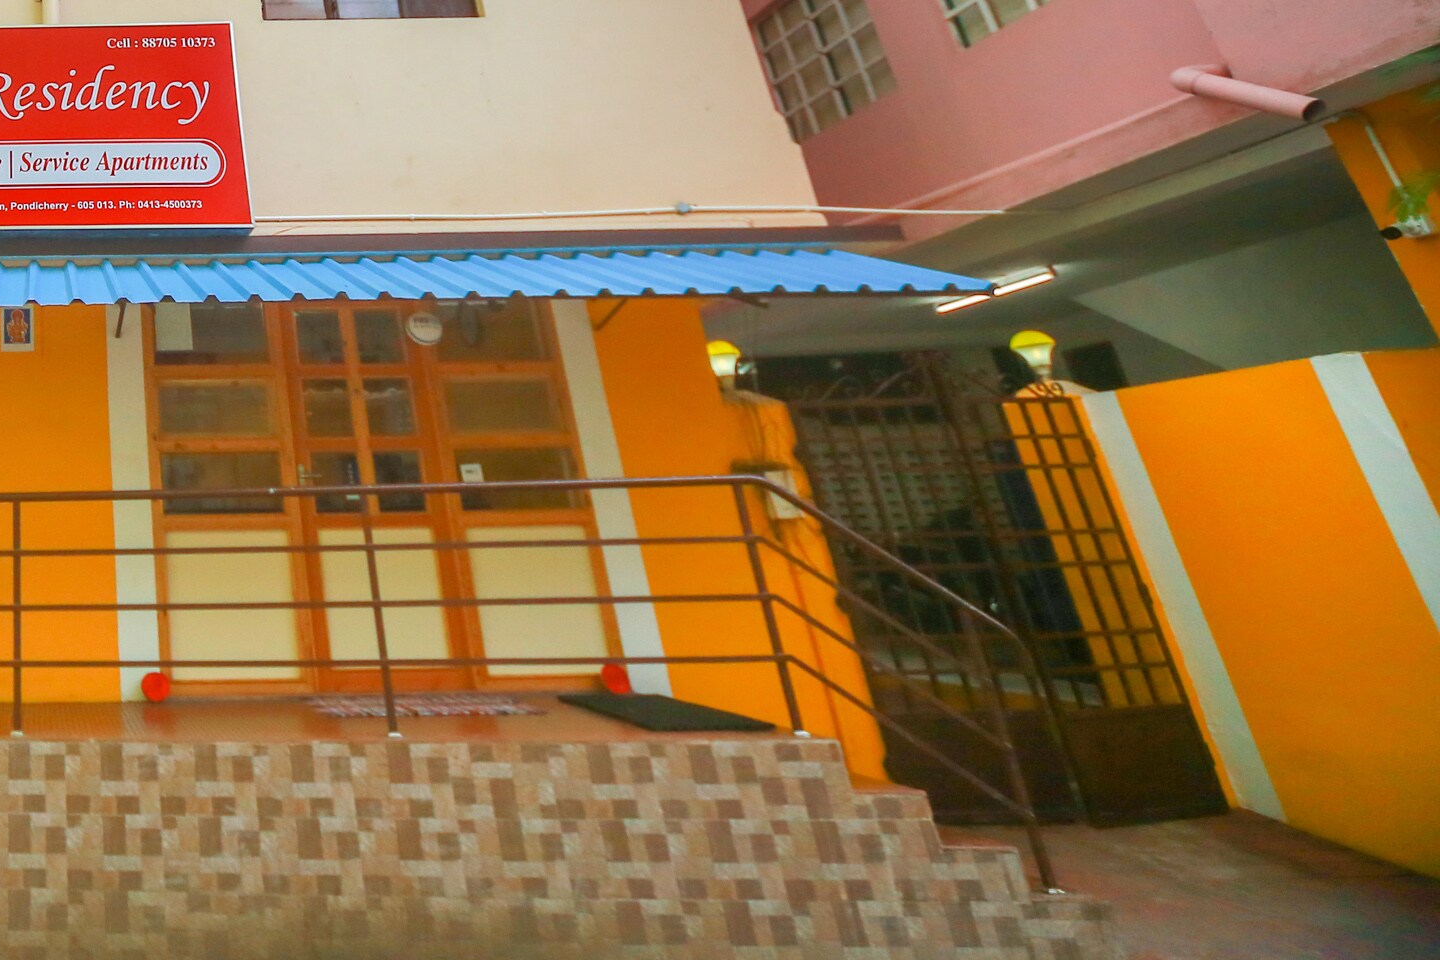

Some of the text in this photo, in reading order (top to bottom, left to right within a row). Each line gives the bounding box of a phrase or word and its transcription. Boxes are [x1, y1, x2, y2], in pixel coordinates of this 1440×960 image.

[106, 37, 131, 49] Cell
[141, 37, 177, 48] 88705
[181, 37, 216, 48] 10373
[19, 151, 90, 172] Service
[95, 151, 208, 176] Apartments
[10, 201, 69, 212] Pondicherry
[77, 200, 95, 210] 605
[96, 200, 117, 210] 013.
[119, 200, 136, 210] Ph:
[137, 199, 203, 209] 0413-4500373
